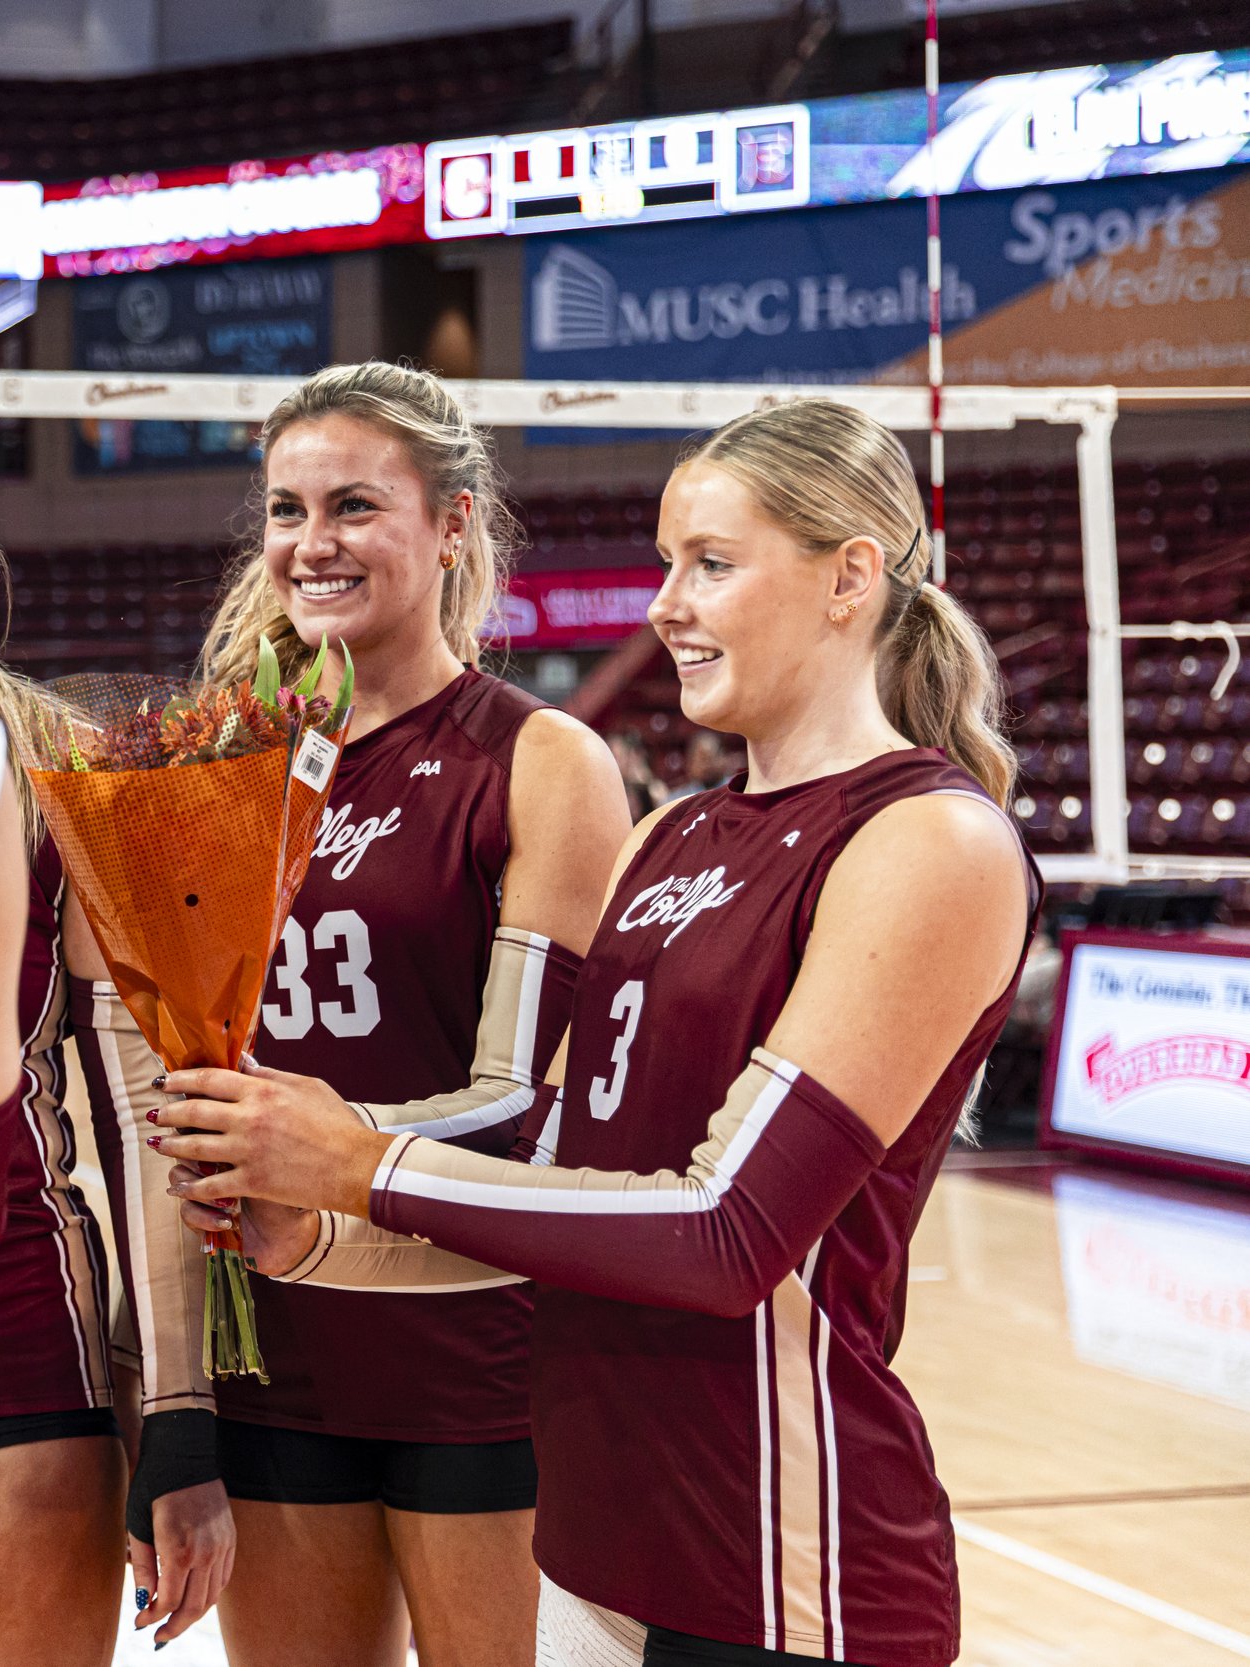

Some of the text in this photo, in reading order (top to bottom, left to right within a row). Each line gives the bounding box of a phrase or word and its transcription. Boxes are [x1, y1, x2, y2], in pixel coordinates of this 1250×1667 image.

[1003, 191, 1222, 278] Sports
[617, 264, 978, 344] MUSC Healh
[1050, 248, 1250, 311] Medicin
[262, 909, 381, 1040] 33
[588, 980, 644, 1121] 3
